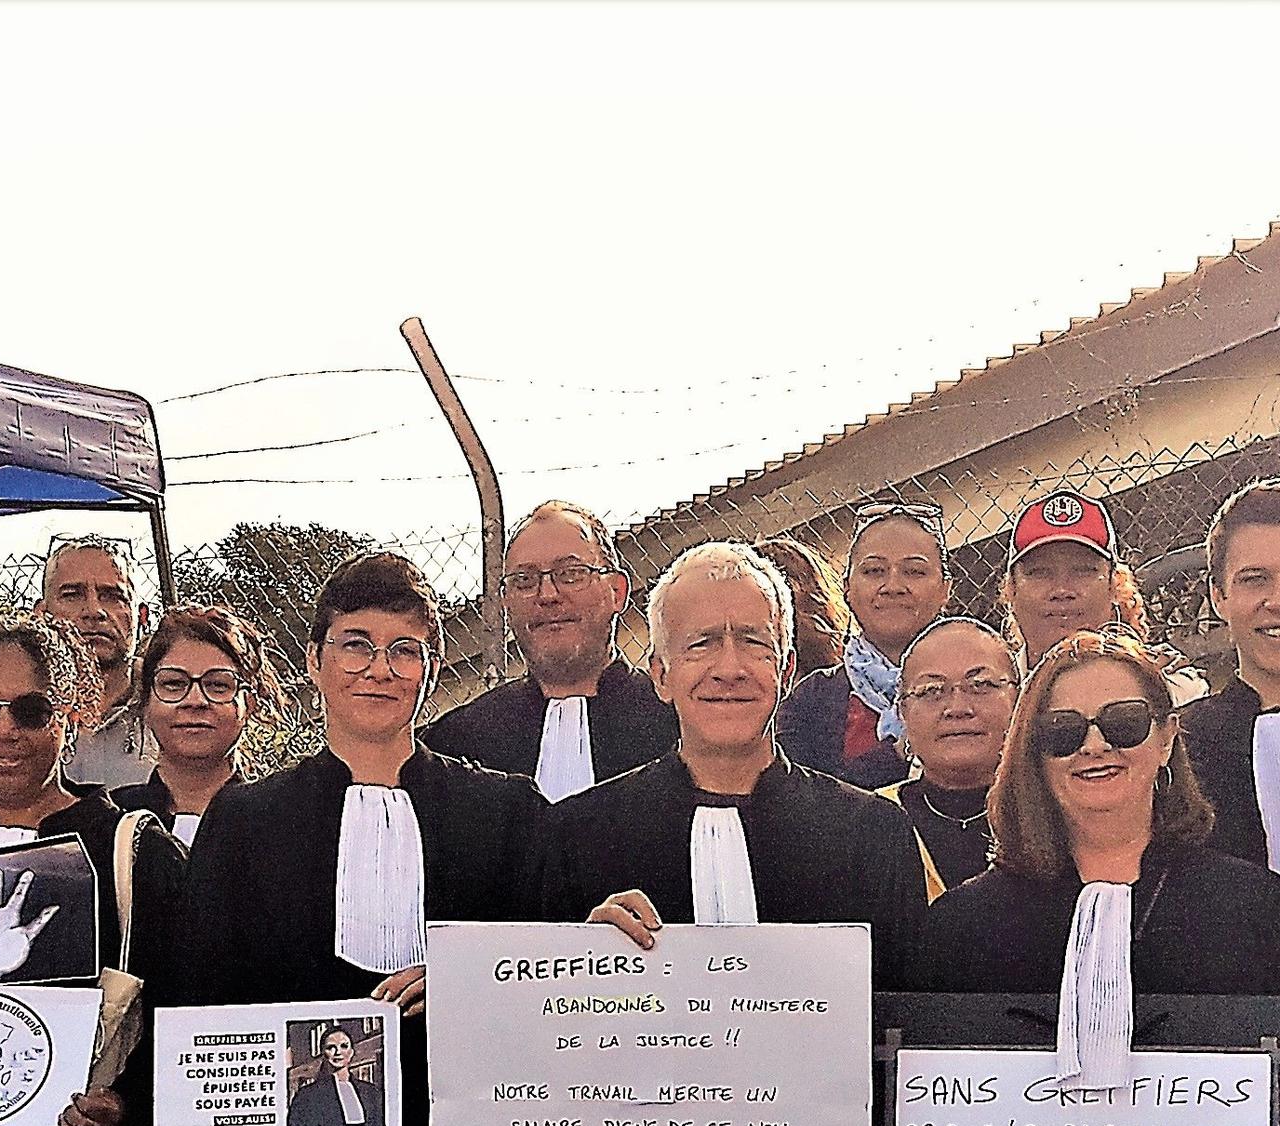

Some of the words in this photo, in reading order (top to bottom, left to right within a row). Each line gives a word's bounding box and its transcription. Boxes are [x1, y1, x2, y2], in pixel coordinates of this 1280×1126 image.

[494, 950, 646, 982] GREFFIERS
[707, 956, 748, 972] LES
[542, 994, 666, 1016] ABANDONNÉS
[688, 998, 712, 1013] DU
[730, 998, 828, 1013] MINISTERE
[556, 1036, 582, 1050] DE
[599, 1035, 620, 1048] LA
[636, 1034, 714, 1048] JUSTICE
[725, 1028, 742, 1048] !!
[178, 1054, 192, 1066] JE
[196, 1052, 214, 1063] NE
[218, 1051, 247, 1062] SUIS
[251, 1050, 275, 1060] PAS
[186, 1064, 276, 1078] CONSIDÉRÉE,
[203, 1080, 256, 1094] ÉPUISÉE
[260, 1081, 276, 1091] ET
[494, 1084, 549, 1102] NOTRE
[568, 1085, 638, 1101] TRAVAIL
[659, 1086, 734, 1102] MERITE
[746, 1086, 777, 1103] UN
[905, 1074, 998, 1105] SANS
[196, 1098, 231, 1110] SOUS
[235, 1094, 276, 1108] PAYÉE
[216, 1116, 244, 1125] VOUS
[246, 1114, 274, 1124] AUSSI
